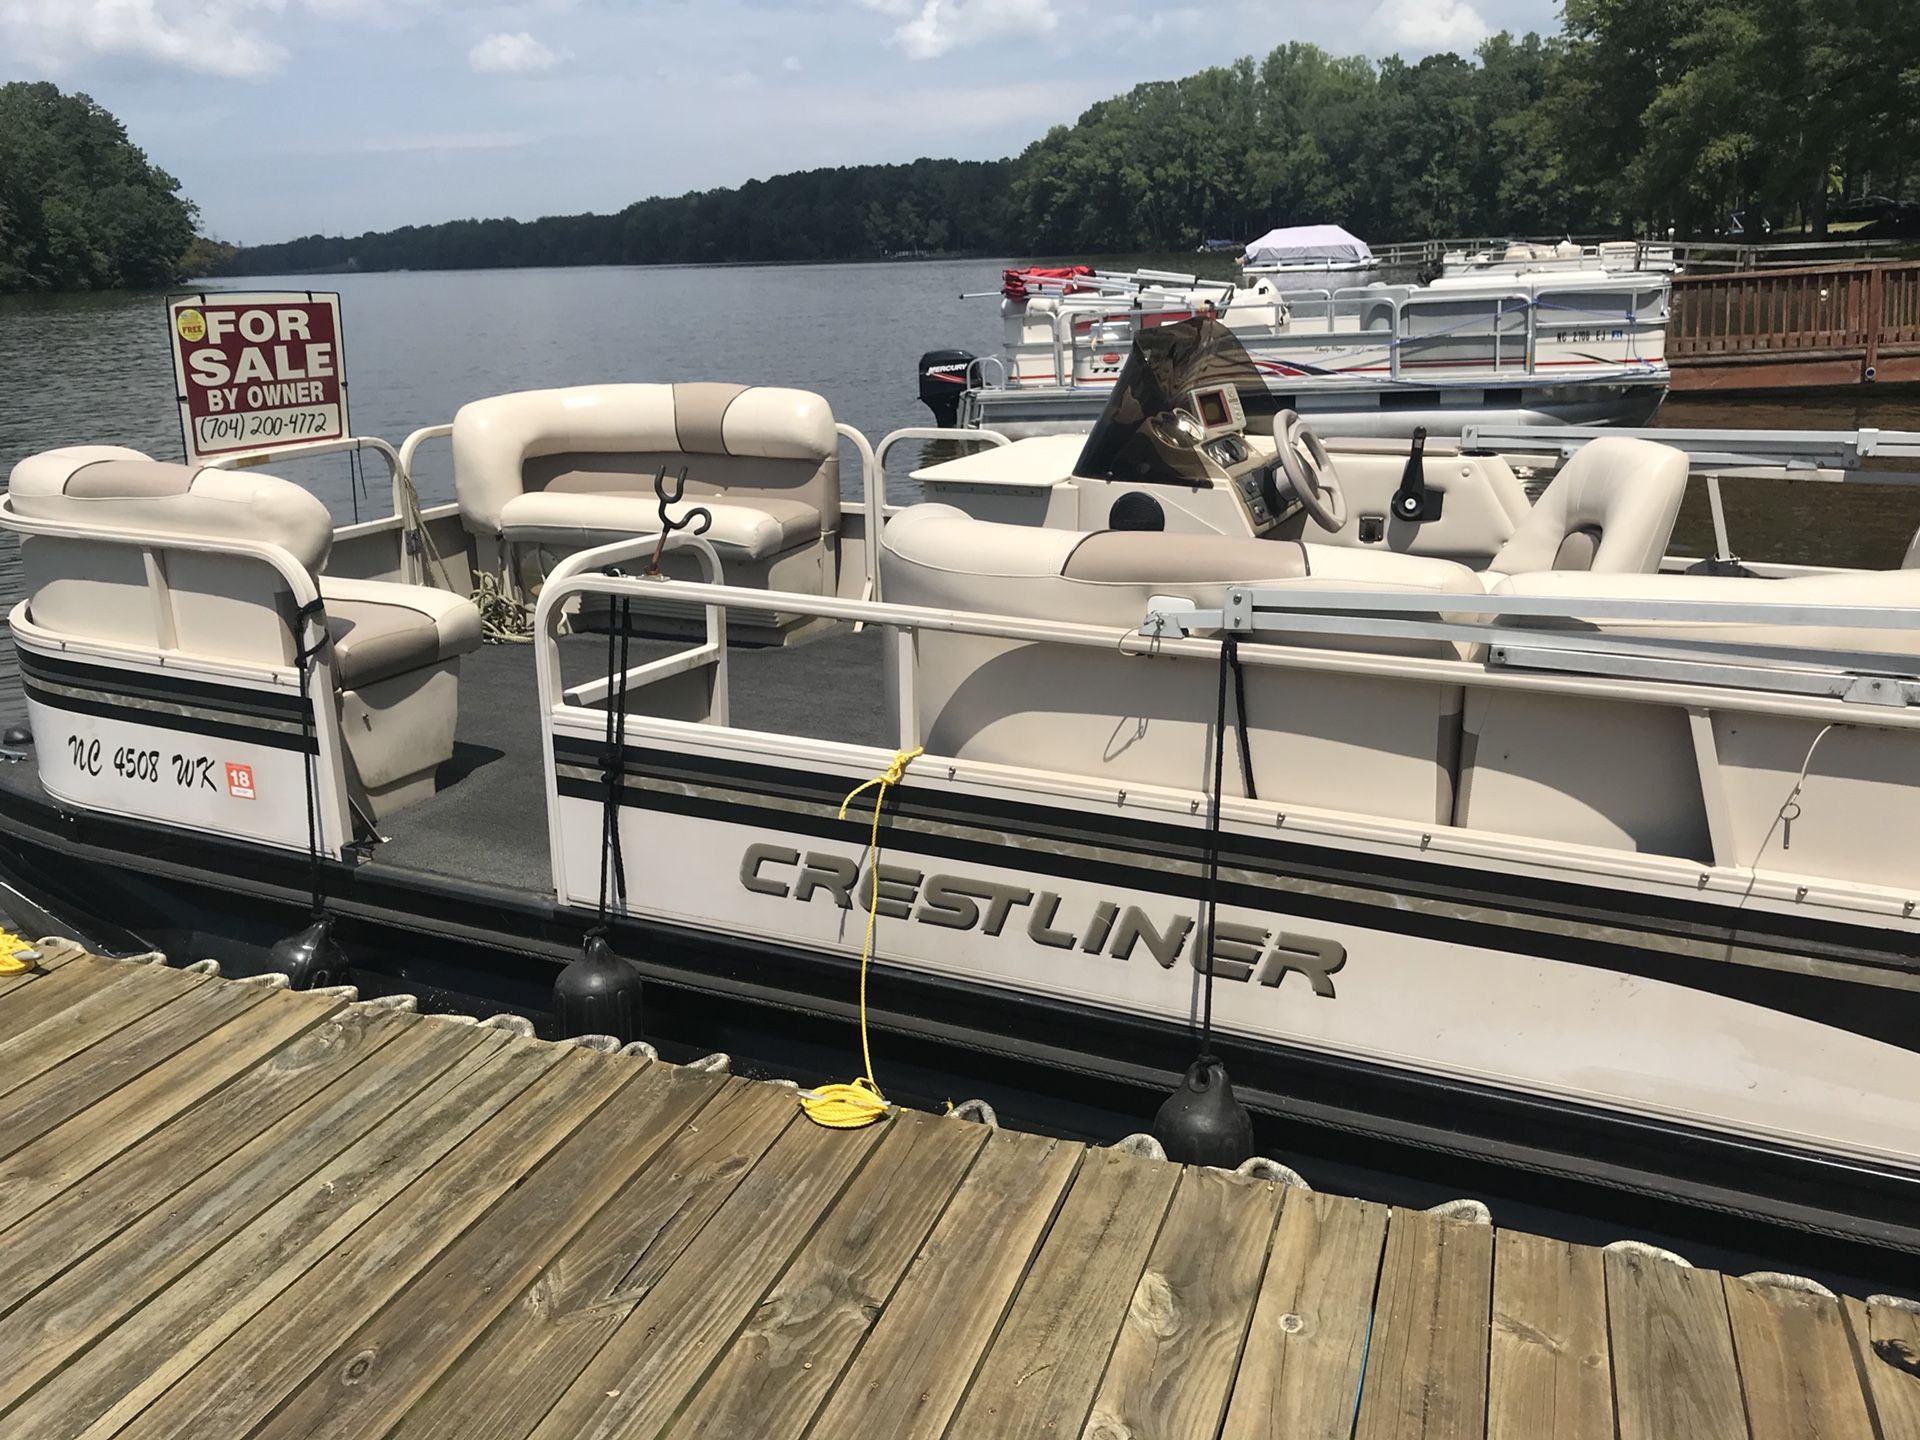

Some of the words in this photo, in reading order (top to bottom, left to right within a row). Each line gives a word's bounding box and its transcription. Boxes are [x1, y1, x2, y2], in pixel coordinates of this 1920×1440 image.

[182, 325, 203, 334] FREE
[205, 309, 312, 344] FOR
[189, 343, 334, 387] SALE
[926, 363, 968, 376] MERCURY
[206, 388, 239, 412] BY
[247, 381, 325, 409] OWNER
[200, 414, 245, 443] (704)
[250, 412, 327, 436] 200-4772
[68, 735, 103, 776] NC
[113, 746, 160, 783] 4508
[171, 754, 218, 792] WK
[229, 769, 250, 787] 18
[739, 841, 1348, 998] CRESTLINER
